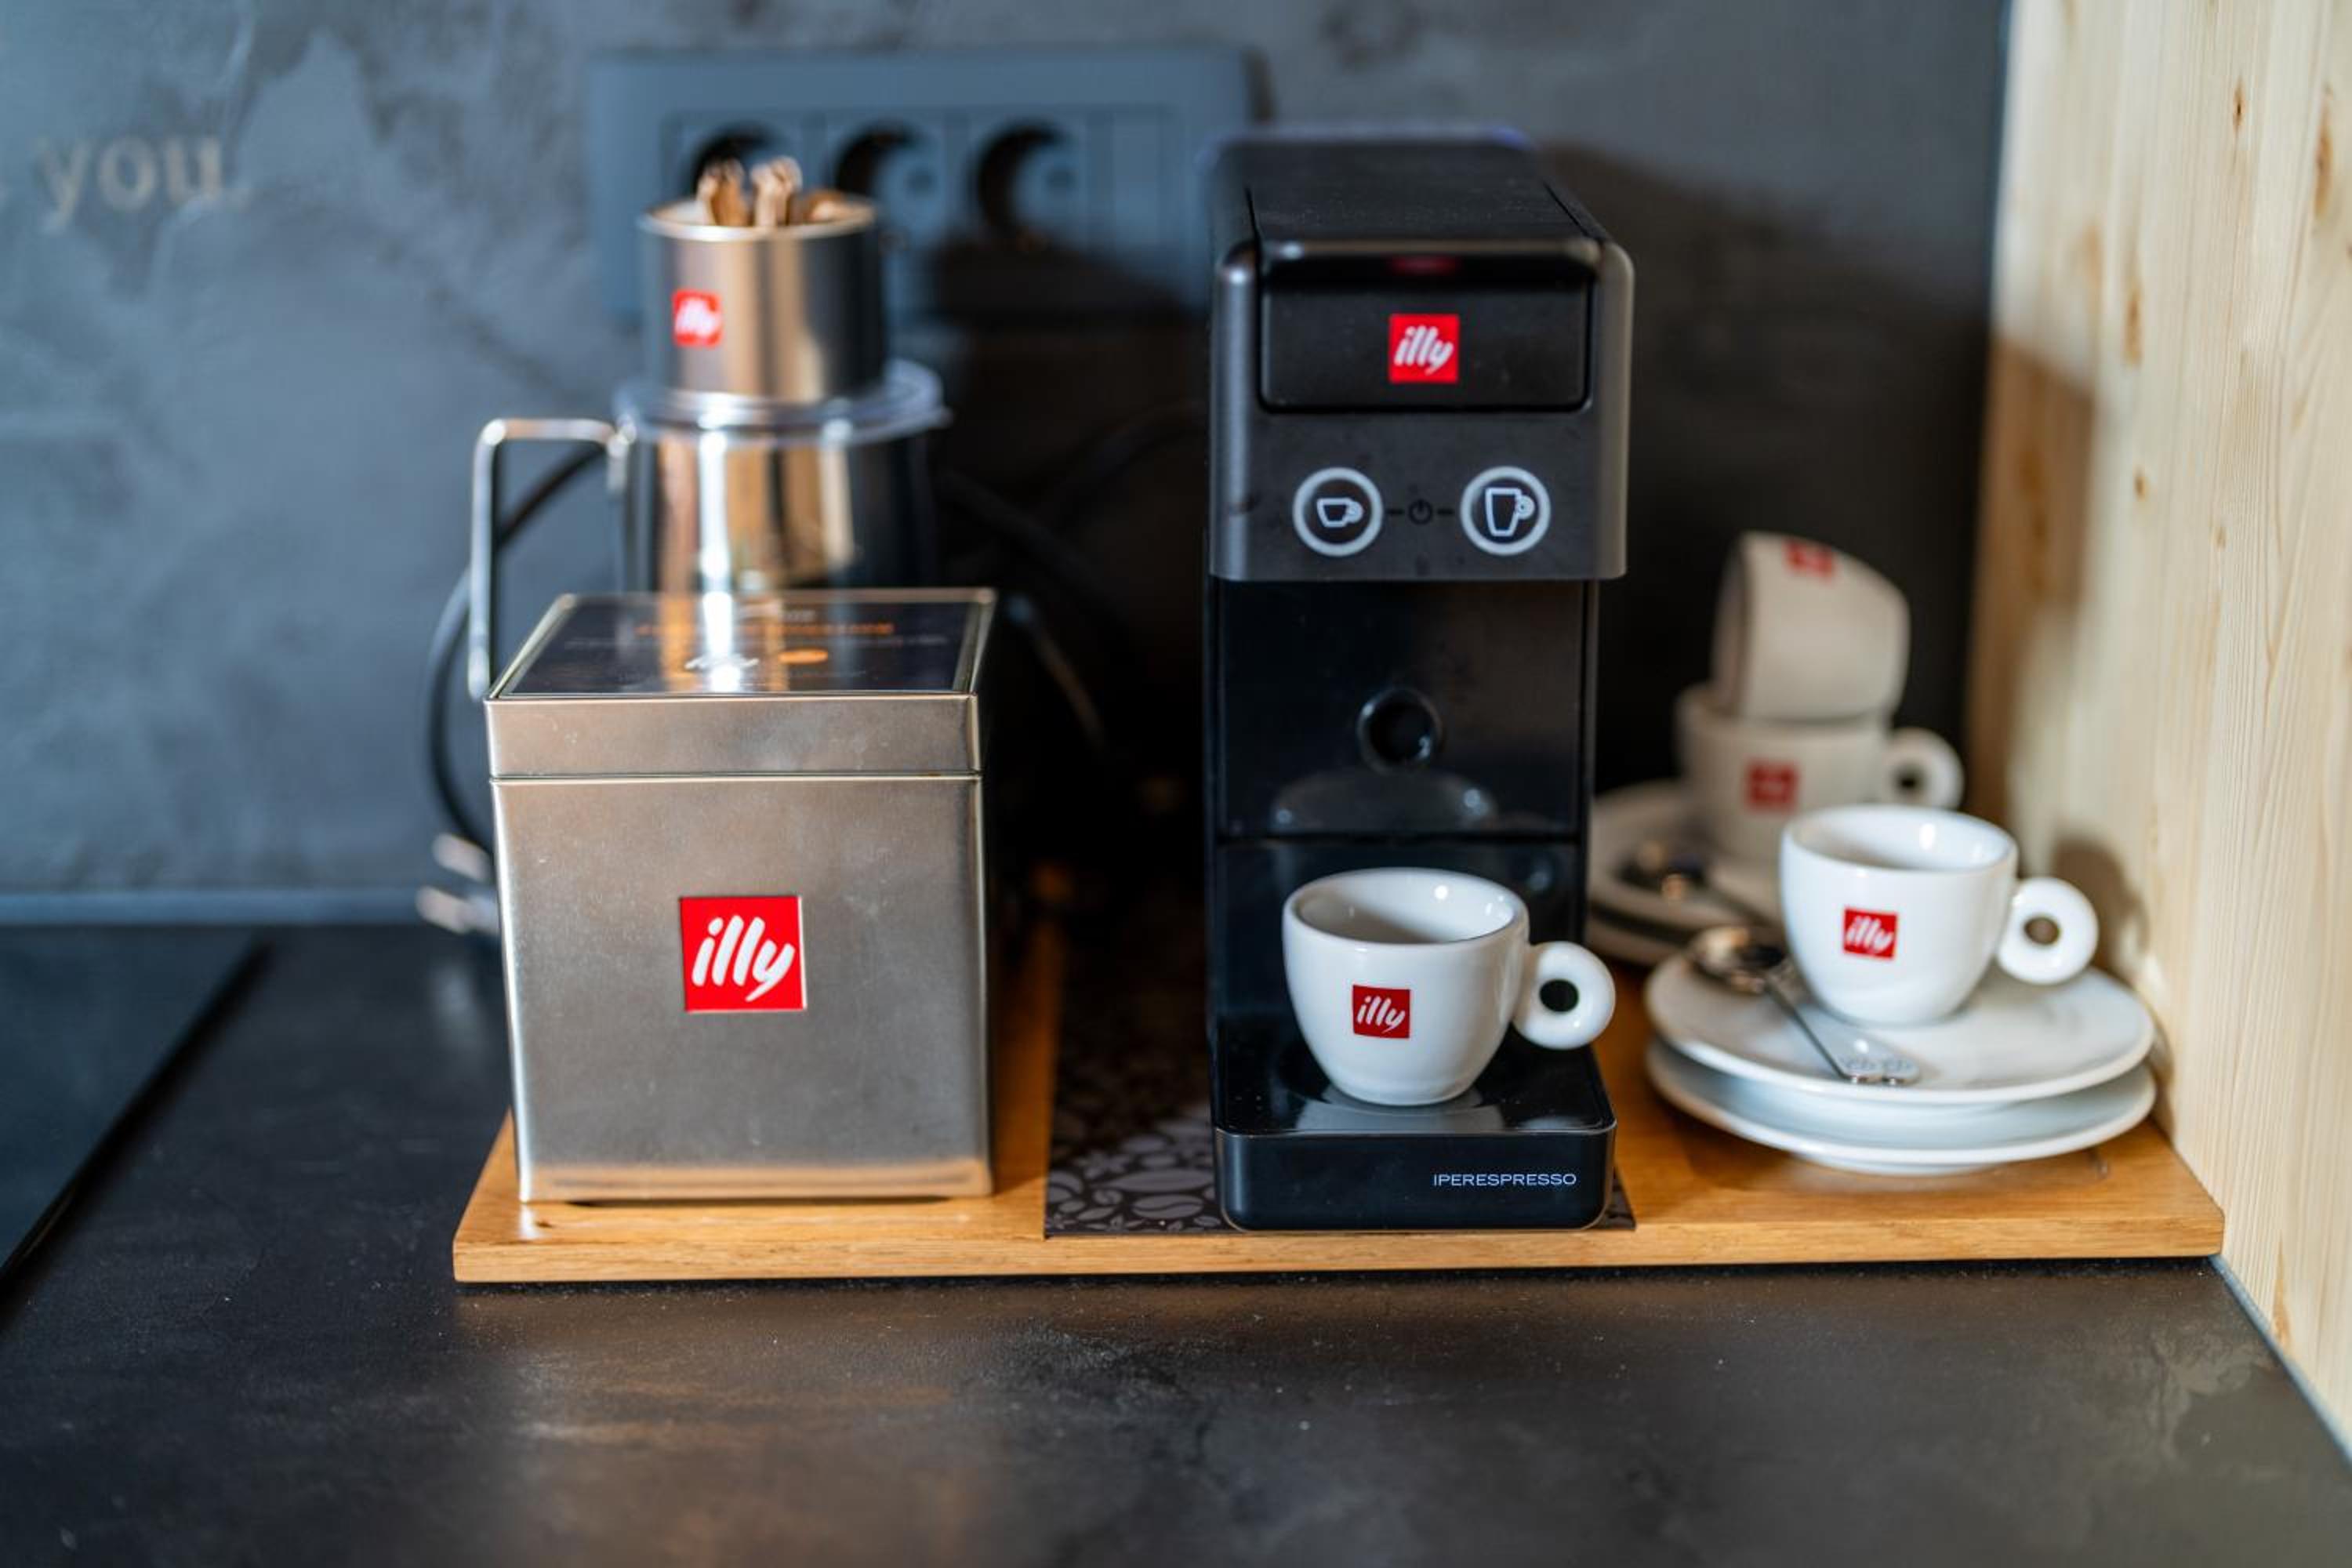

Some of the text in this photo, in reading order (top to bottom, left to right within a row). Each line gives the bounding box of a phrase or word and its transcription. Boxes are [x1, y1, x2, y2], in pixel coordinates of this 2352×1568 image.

[1393, 324, 1454, 376] illy
[1845, 914, 1895, 954] illy
[691, 914, 796, 1003] illy
[1356, 994, 1406, 1034] illy
[1433, 1173, 1577, 1187] IPERESPRESSO
